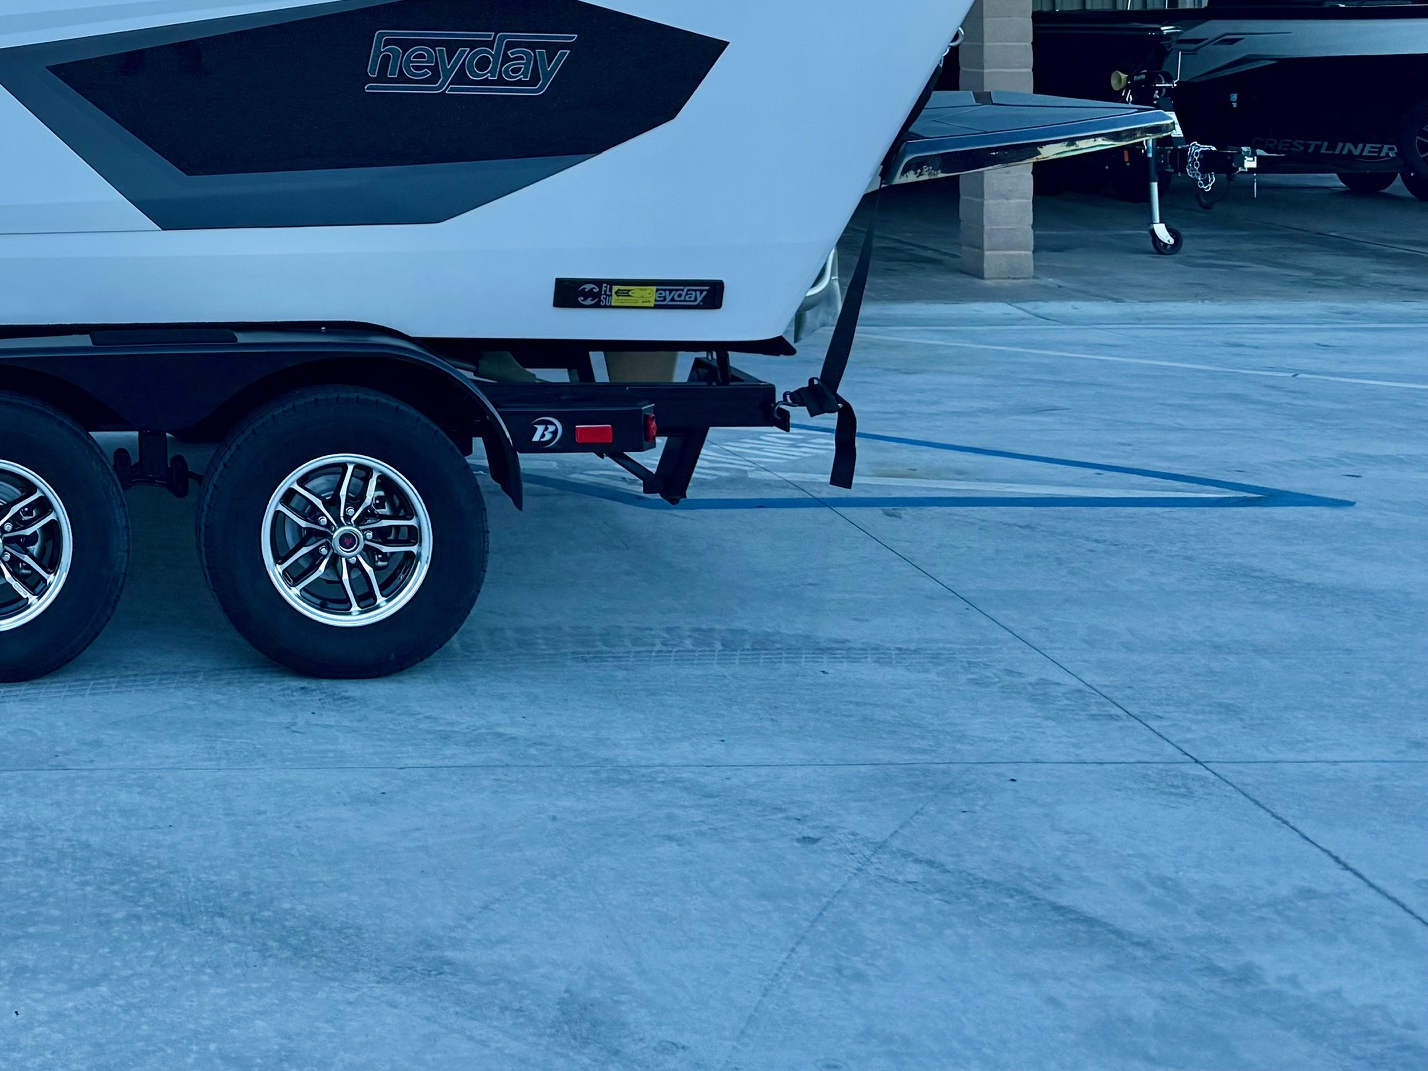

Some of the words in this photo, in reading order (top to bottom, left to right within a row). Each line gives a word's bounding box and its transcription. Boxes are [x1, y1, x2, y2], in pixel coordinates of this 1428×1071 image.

[364, 30, 578, 96] heyday
[1252, 137, 1398, 158] CRESTLINER
[655, 286, 710, 306] eyday
